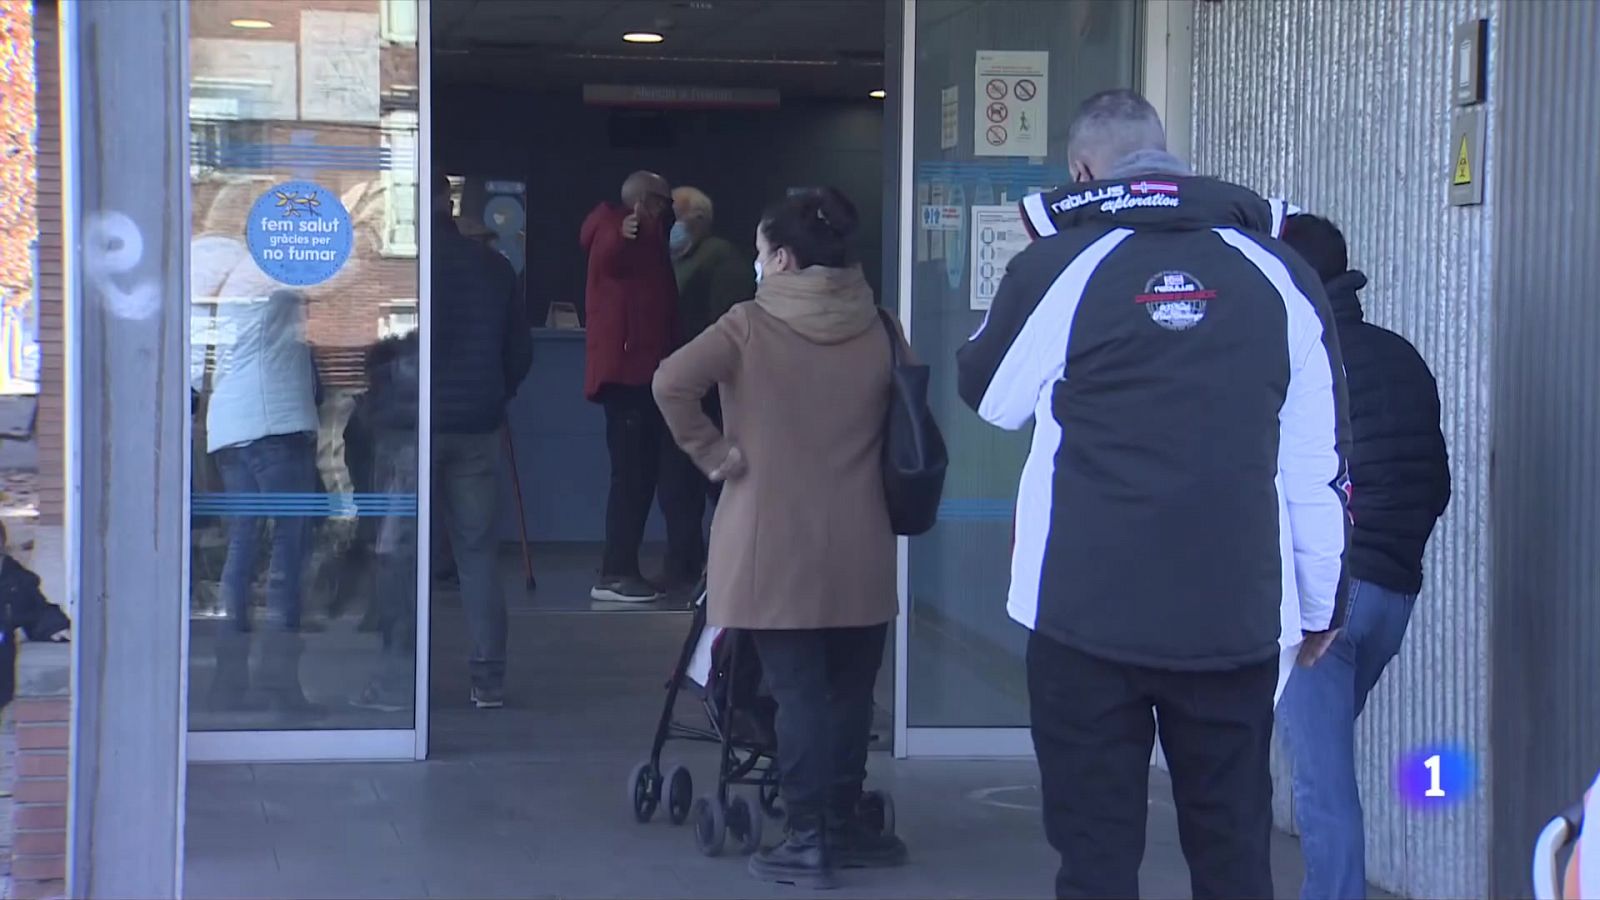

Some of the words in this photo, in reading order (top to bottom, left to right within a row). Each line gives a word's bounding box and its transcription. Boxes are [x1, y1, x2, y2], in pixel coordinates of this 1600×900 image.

[1100, 193, 1179, 214] exploration
[261, 217, 293, 232] fem
[299, 217, 340, 233] salut
[270, 234, 309, 247] gràcies
[312, 236, 331, 246] per
[263, 249, 284, 261] no
[289, 246, 336, 261] fumar
